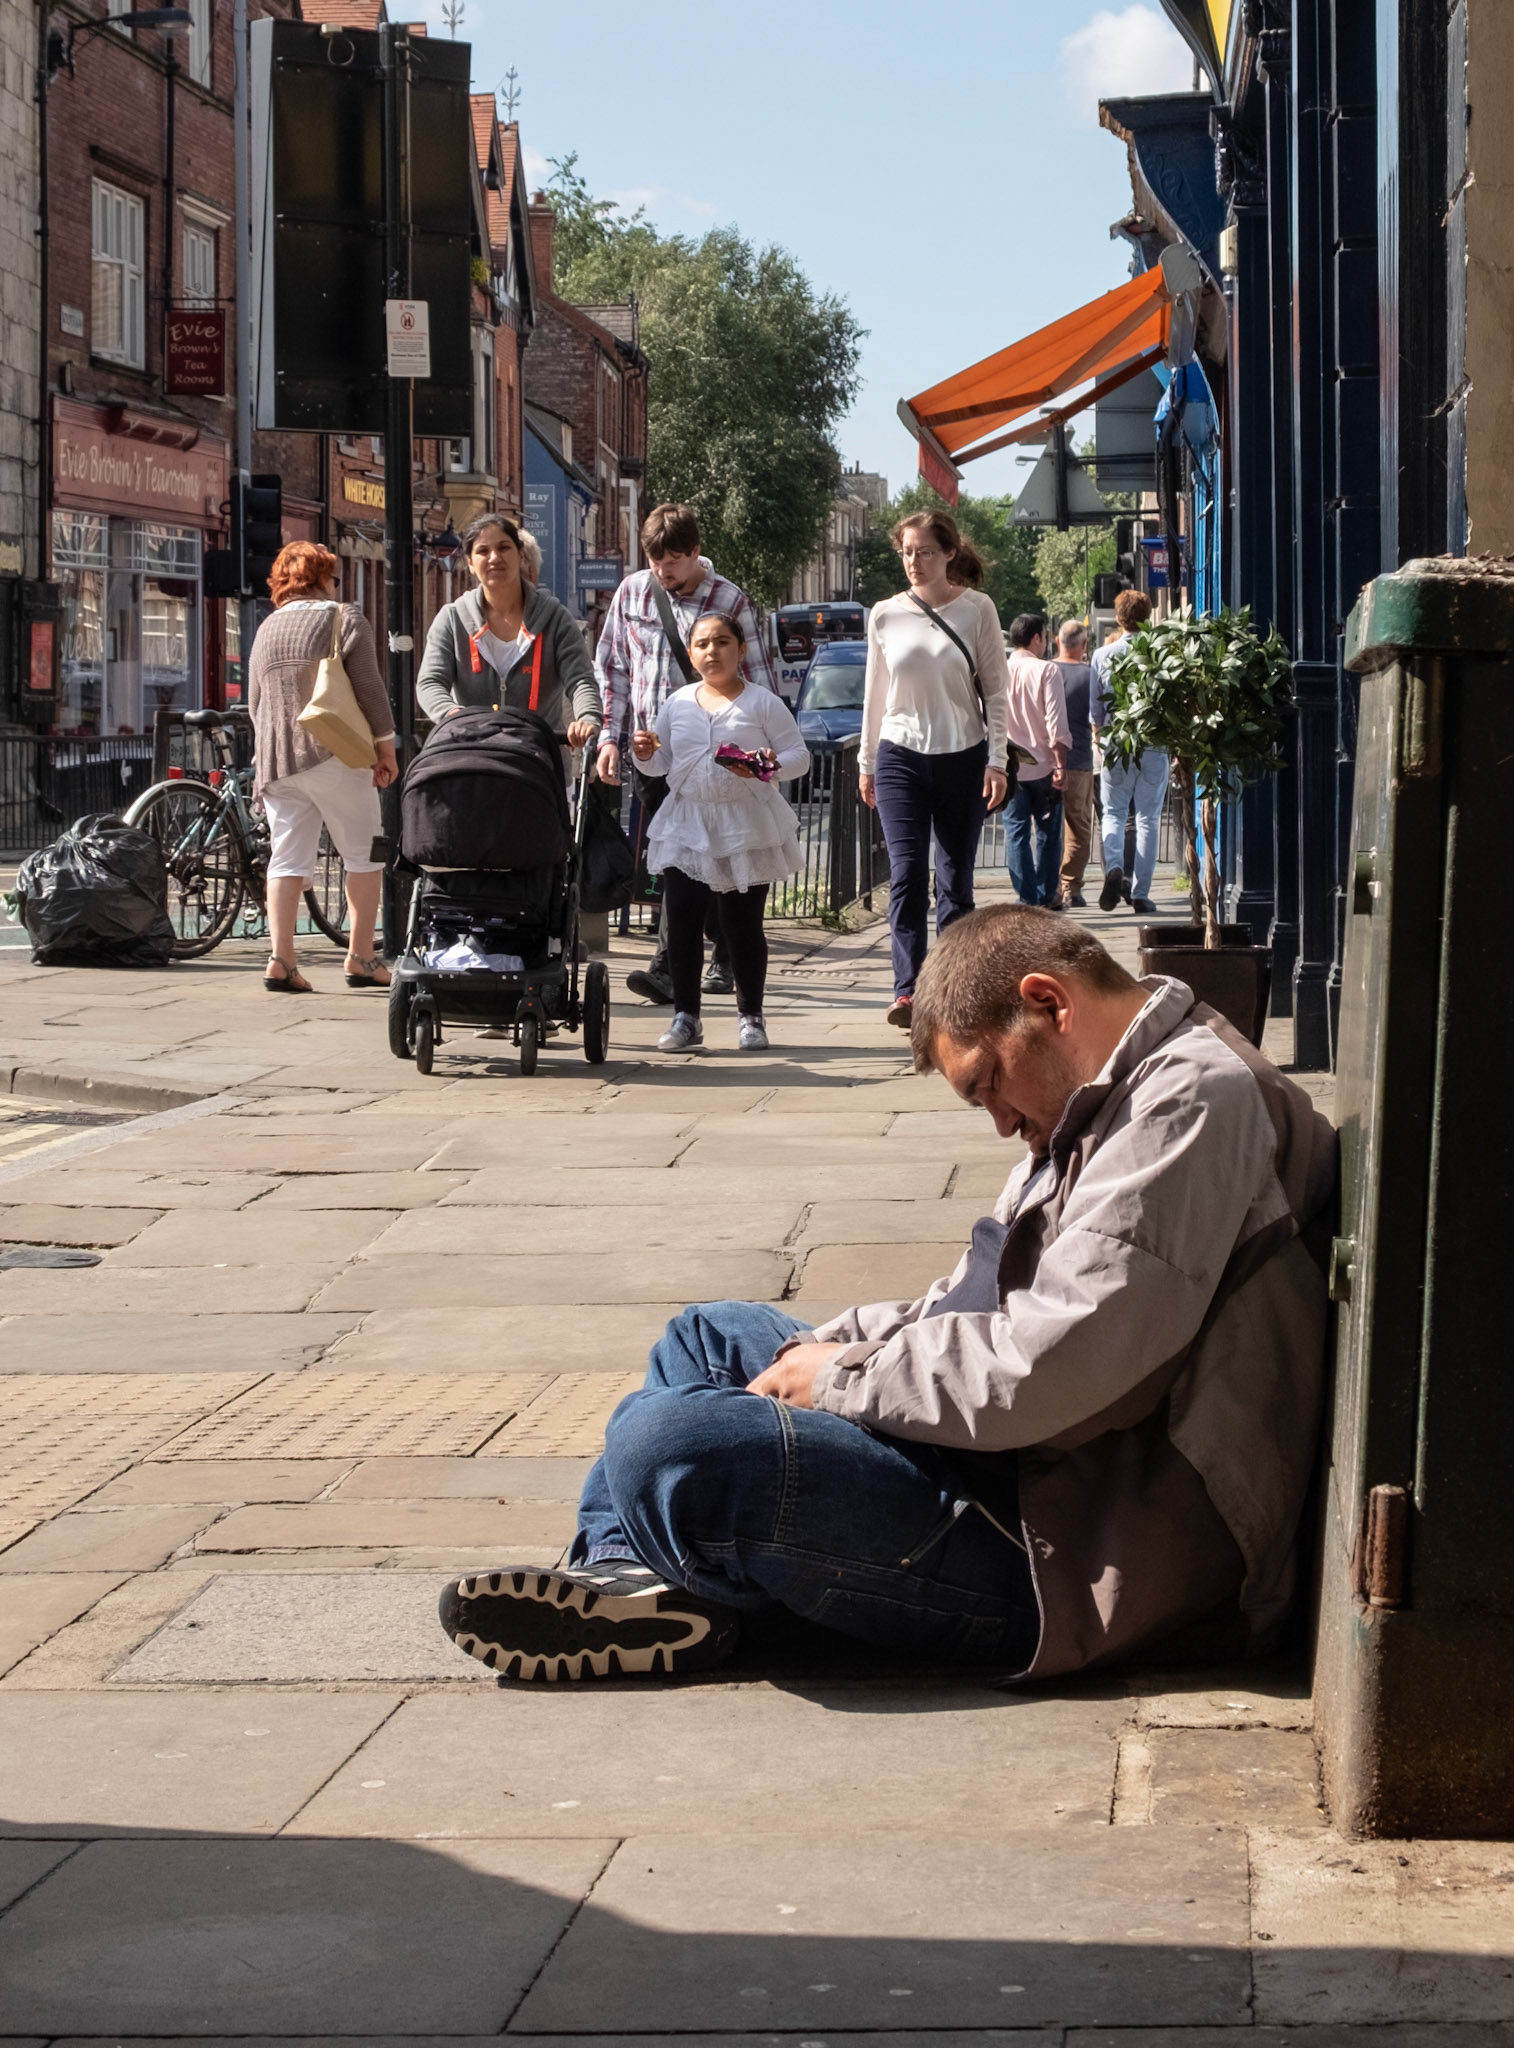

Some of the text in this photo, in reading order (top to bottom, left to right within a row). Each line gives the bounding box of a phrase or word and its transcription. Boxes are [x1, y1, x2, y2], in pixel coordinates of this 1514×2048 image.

[169, 320, 220, 342] Evie
[184, 359, 207, 370] Tea
[174, 374, 215, 385] Rooms
[59, 439, 88, 479] Evie
[89, 445, 142, 493] Brown's
[145, 457, 200, 502] Tearooms
[344, 476, 386, 509] WHITE HORS
[528, 492, 550, 502] Ray
[816, 612, 823, 624] 2
[782, 669, 807, 679] PAR
